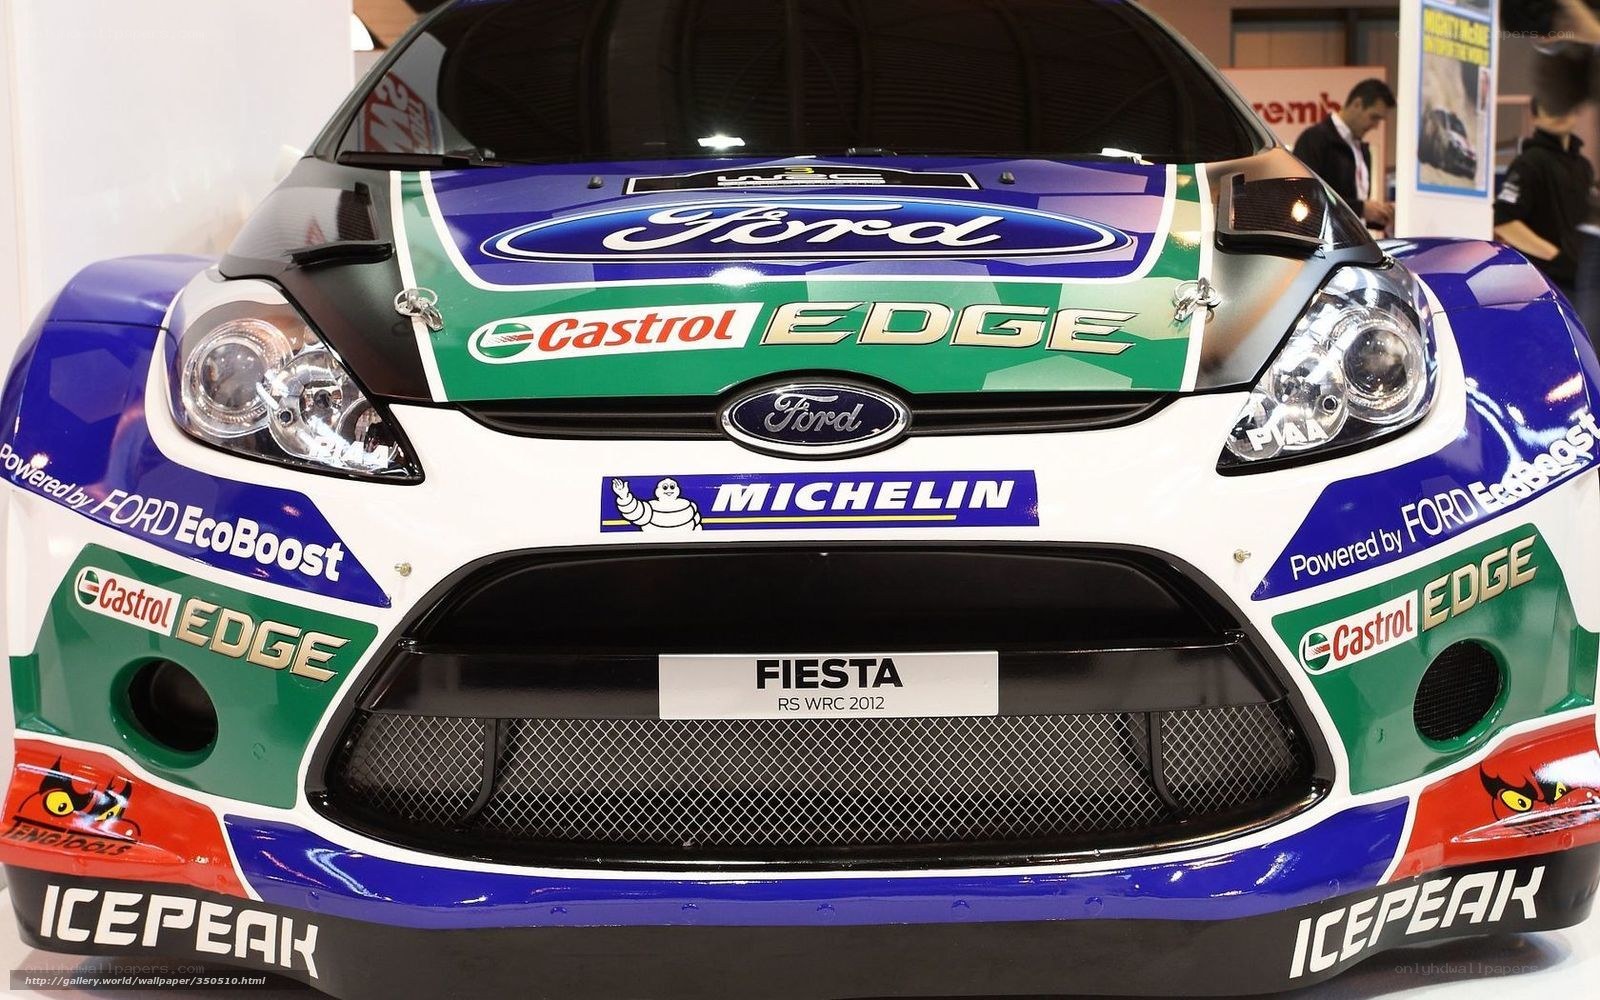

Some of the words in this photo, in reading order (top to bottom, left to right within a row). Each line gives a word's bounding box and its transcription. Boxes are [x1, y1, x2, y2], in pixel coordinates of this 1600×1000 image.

[602, 203, 1000, 250] Ford
[537, 309, 734, 353] Castrol
[760, 301, 1140, 355] EDGE
[764, 393, 864, 432] Ford
[1248, 419, 1329, 450] PIAA
[0, 443, 76, 498] Powered
[65, 487, 94, 509] by
[90, 489, 180, 537] FORD
[175, 504, 344, 582] EcoBoost
[711, 481, 1014, 512] MICHELIN
[1290, 540, 1380, 580] Powered
[1379, 528, 1404, 553] by
[1401, 488, 1478, 543] FORD
[1333, 599, 1413, 661] Castrol
[1422, 533, 1539, 632] EDGE
[99, 577, 172, 629] Castrol
[175, 597, 351, 682] EDGE
[756, 658, 903, 689] FIESTA
[778, 697, 799, 711] RS
[804, 697, 845, 711] WRC
[849, 696, 885, 710] 2012
[40, 884, 319, 979] ICEPEAK
[1289, 866, 1545, 979] ICEPEAK
